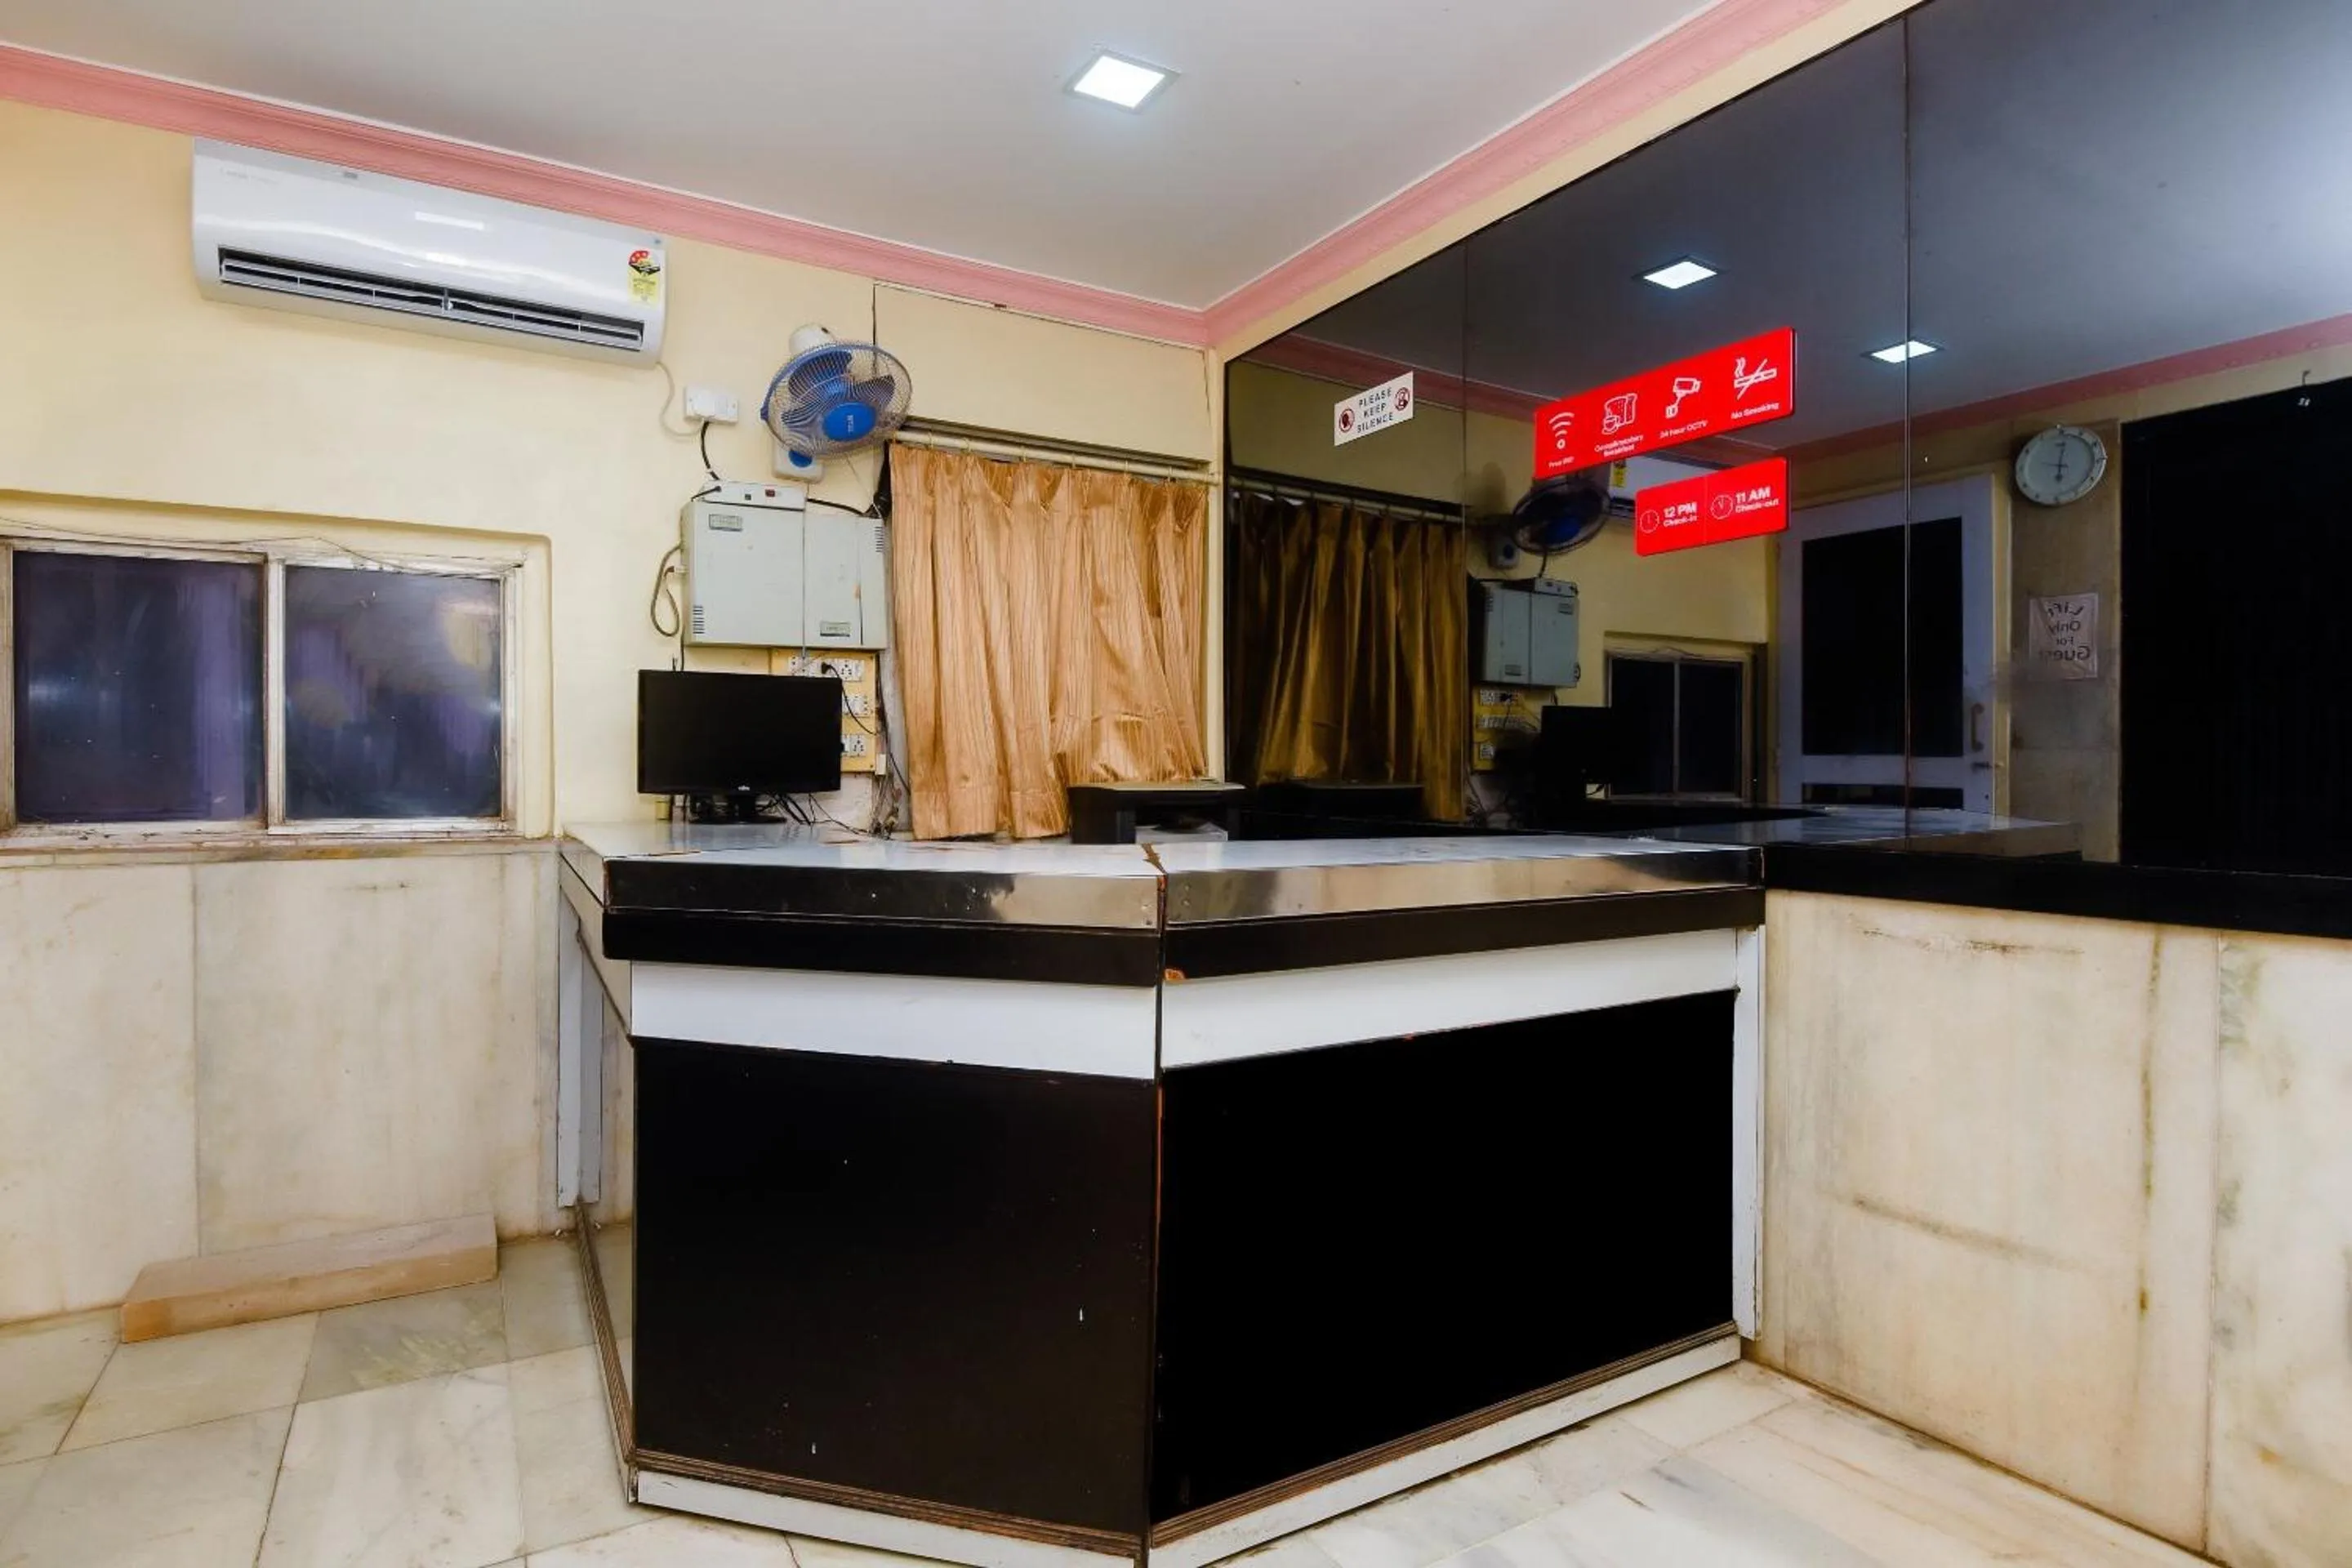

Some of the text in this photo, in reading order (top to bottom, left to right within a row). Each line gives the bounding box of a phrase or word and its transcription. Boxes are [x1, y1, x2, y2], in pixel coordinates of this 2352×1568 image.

[1359, 387, 1392, 408] PLEASE
[1364, 403, 1386, 418] KEEP
[1357, 412, 1393, 434] SILENCE
[1735, 486, 1771, 504] 11 AM
[1664, 501, 1697, 519] 12 PM
